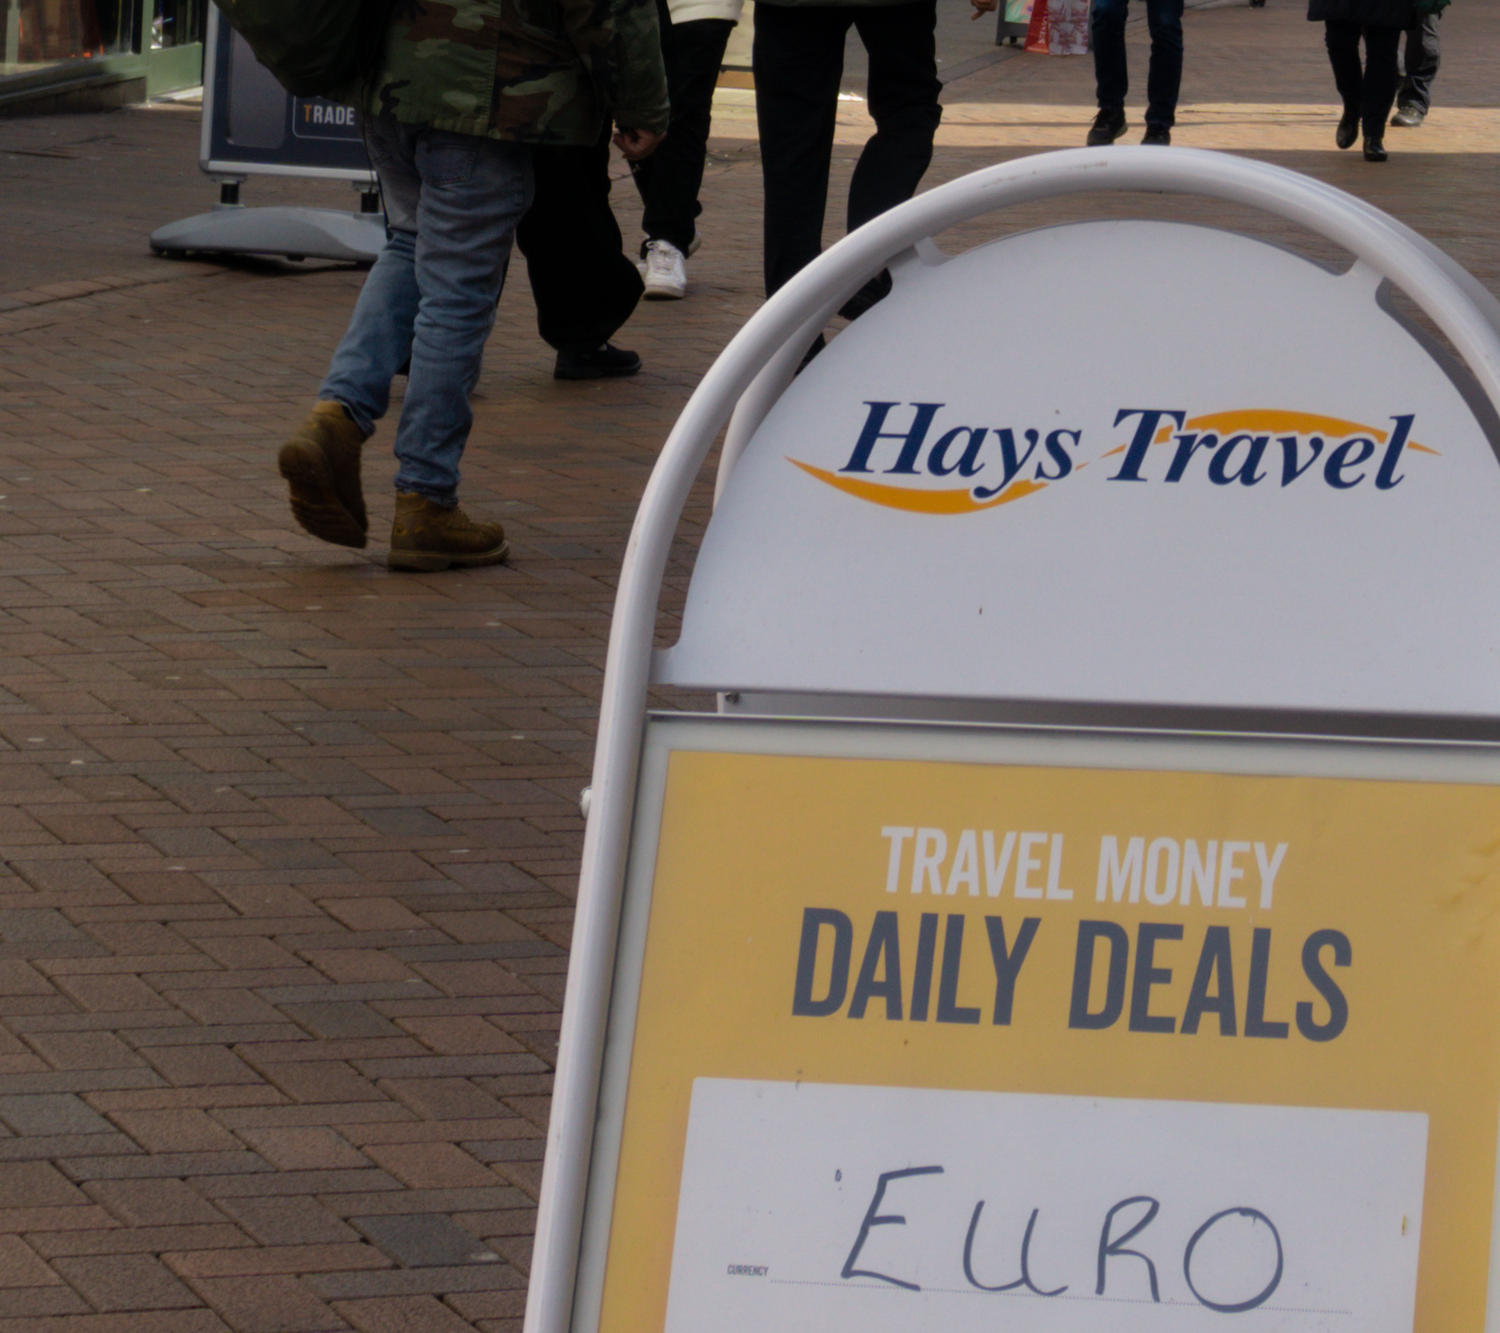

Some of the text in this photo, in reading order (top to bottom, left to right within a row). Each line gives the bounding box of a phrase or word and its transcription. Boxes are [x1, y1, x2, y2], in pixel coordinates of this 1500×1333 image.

[839, 400, 1415, 499] Hays Travel
[882, 826, 1288, 911] TRAVEL MONEY
[792, 907, 1352, 1043] DAILY DEALS
[727, 1263, 770, 1279] CURRENCY
[840, 1164, 1284, 1313] EURO
